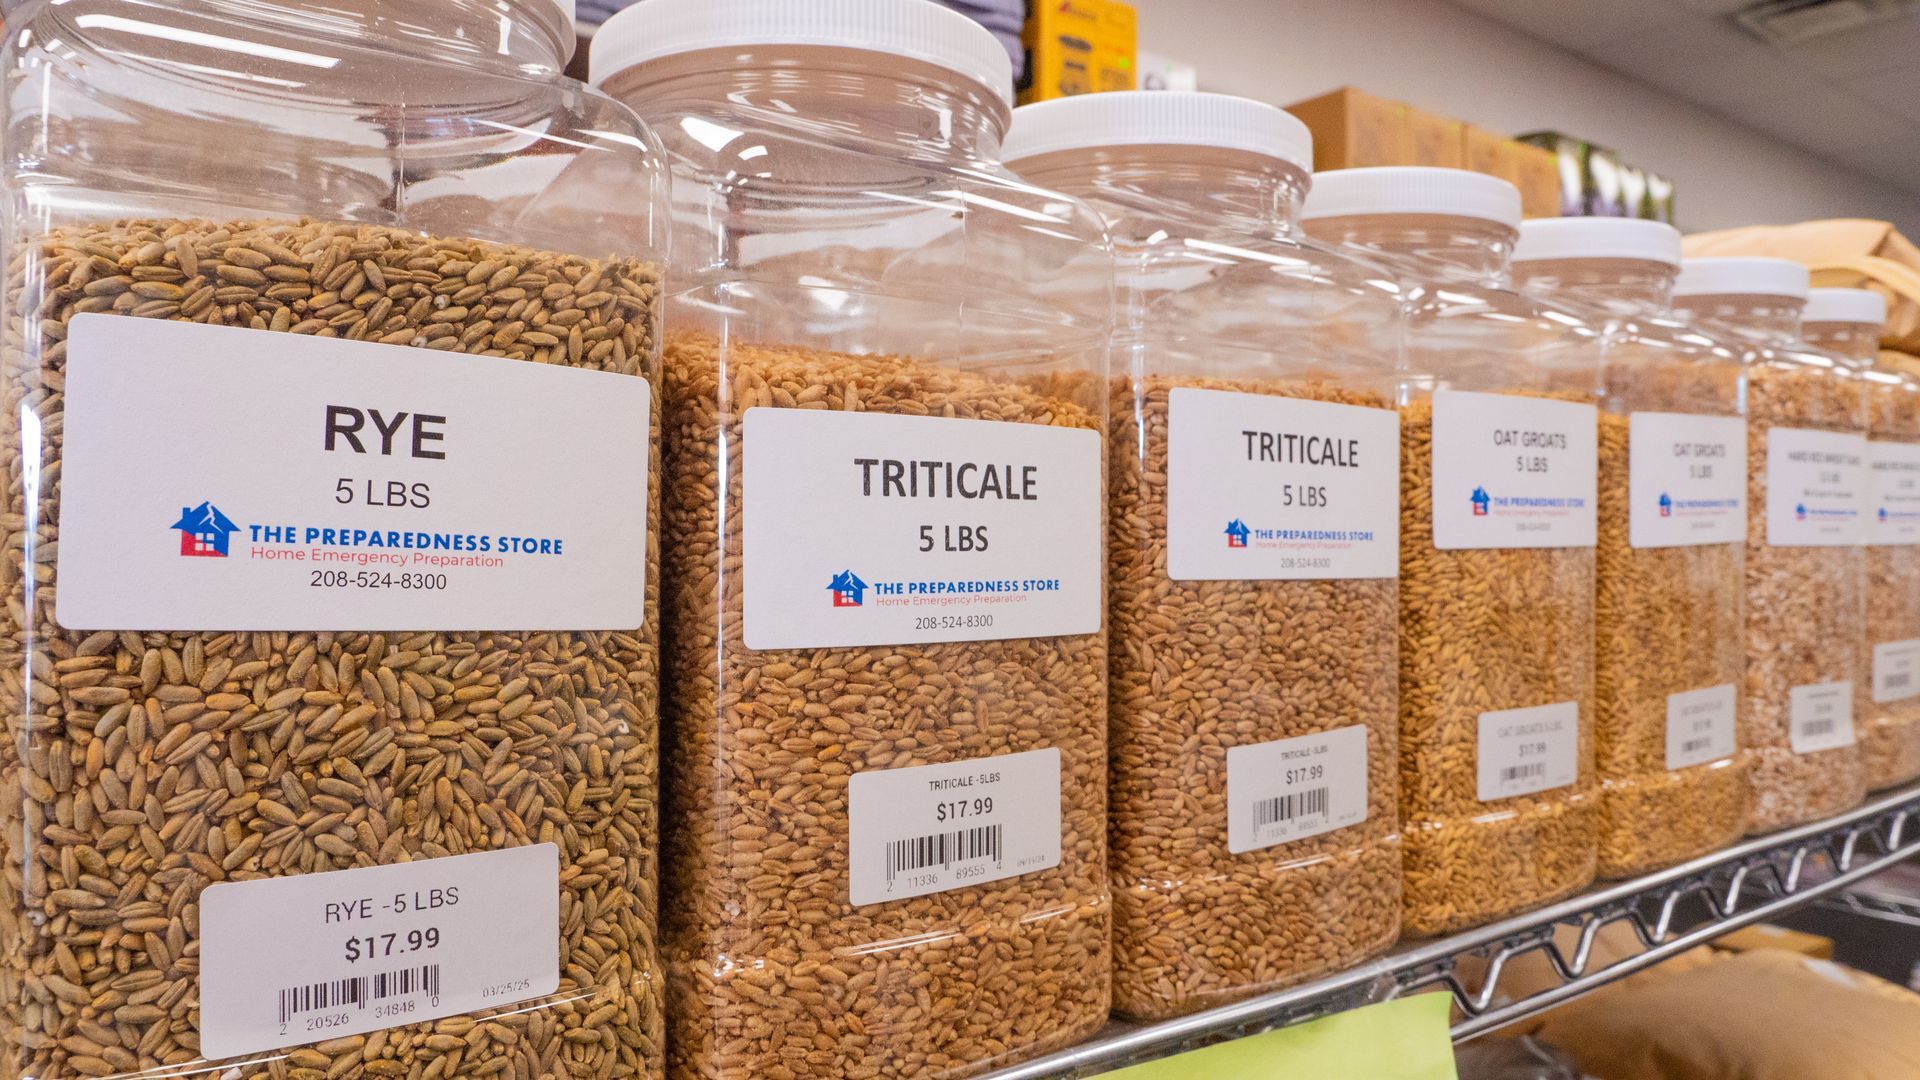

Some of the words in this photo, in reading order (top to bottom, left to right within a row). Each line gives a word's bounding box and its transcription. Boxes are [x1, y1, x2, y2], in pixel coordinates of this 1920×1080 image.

[324, 404, 447, 460] RYE
[1493, 429, 1518, 446] OAT
[1522, 431, 1566, 449] GROATS
[1242, 430, 1358, 467] TRITICALE
[1517, 456, 1524, 472] 5
[1526, 457, 1548, 473] LBS
[854, 458, 1038, 500] TRITICALE
[335, 478, 354, 505] 5
[367, 479, 430, 509] LBS
[1283, 485, 1293, 506] 5
[1299, 485, 1327, 507] LBS
[249, 524, 296, 544] THE
[305, 527, 491, 552] PREPAREDNESS
[500, 536, 563, 555] STORE
[919, 525, 934, 552] 5
[944, 525, 989, 552] LBS
[1254, 529, 1273, 539] THE
[1276, 530, 1346, 541] PREPAREDNESS
[251, 546, 305, 562] Home
[311, 548, 408, 568] Emergency
[413, 552, 504, 569] Preparation
[310, 570, 447, 591] 208-524-8300
[874, 582, 904, 595] THE
[909, 580, 1018, 594] PREPAREDNESS
[1023, 579, 1060, 591] STORE
[876, 597, 910, 606] Home
[913, 595, 971, 607] Emergency
[974, 594, 1027, 605] Preparation
[915, 614, 993, 630] 208-524-8300
[929, 776, 973, 791] TRITICALE
[1286, 764, 1323, 785] $17.99
[937, 797, 993, 823] $17.99
[887, 881, 893, 893] 2
[908, 873, 938, 889] 11336
[325, 898, 373, 924] RYE
[415, 886, 459, 911] LBS
[345, 927, 440, 964] $17.99
[482, 978, 530, 998] 03/25/25
[280, 1023, 288, 1036] 2
[306, 1013, 350, 1032] 20526
[375, 1000, 416, 1019] 34848
[431, 996, 440, 1008] 0
